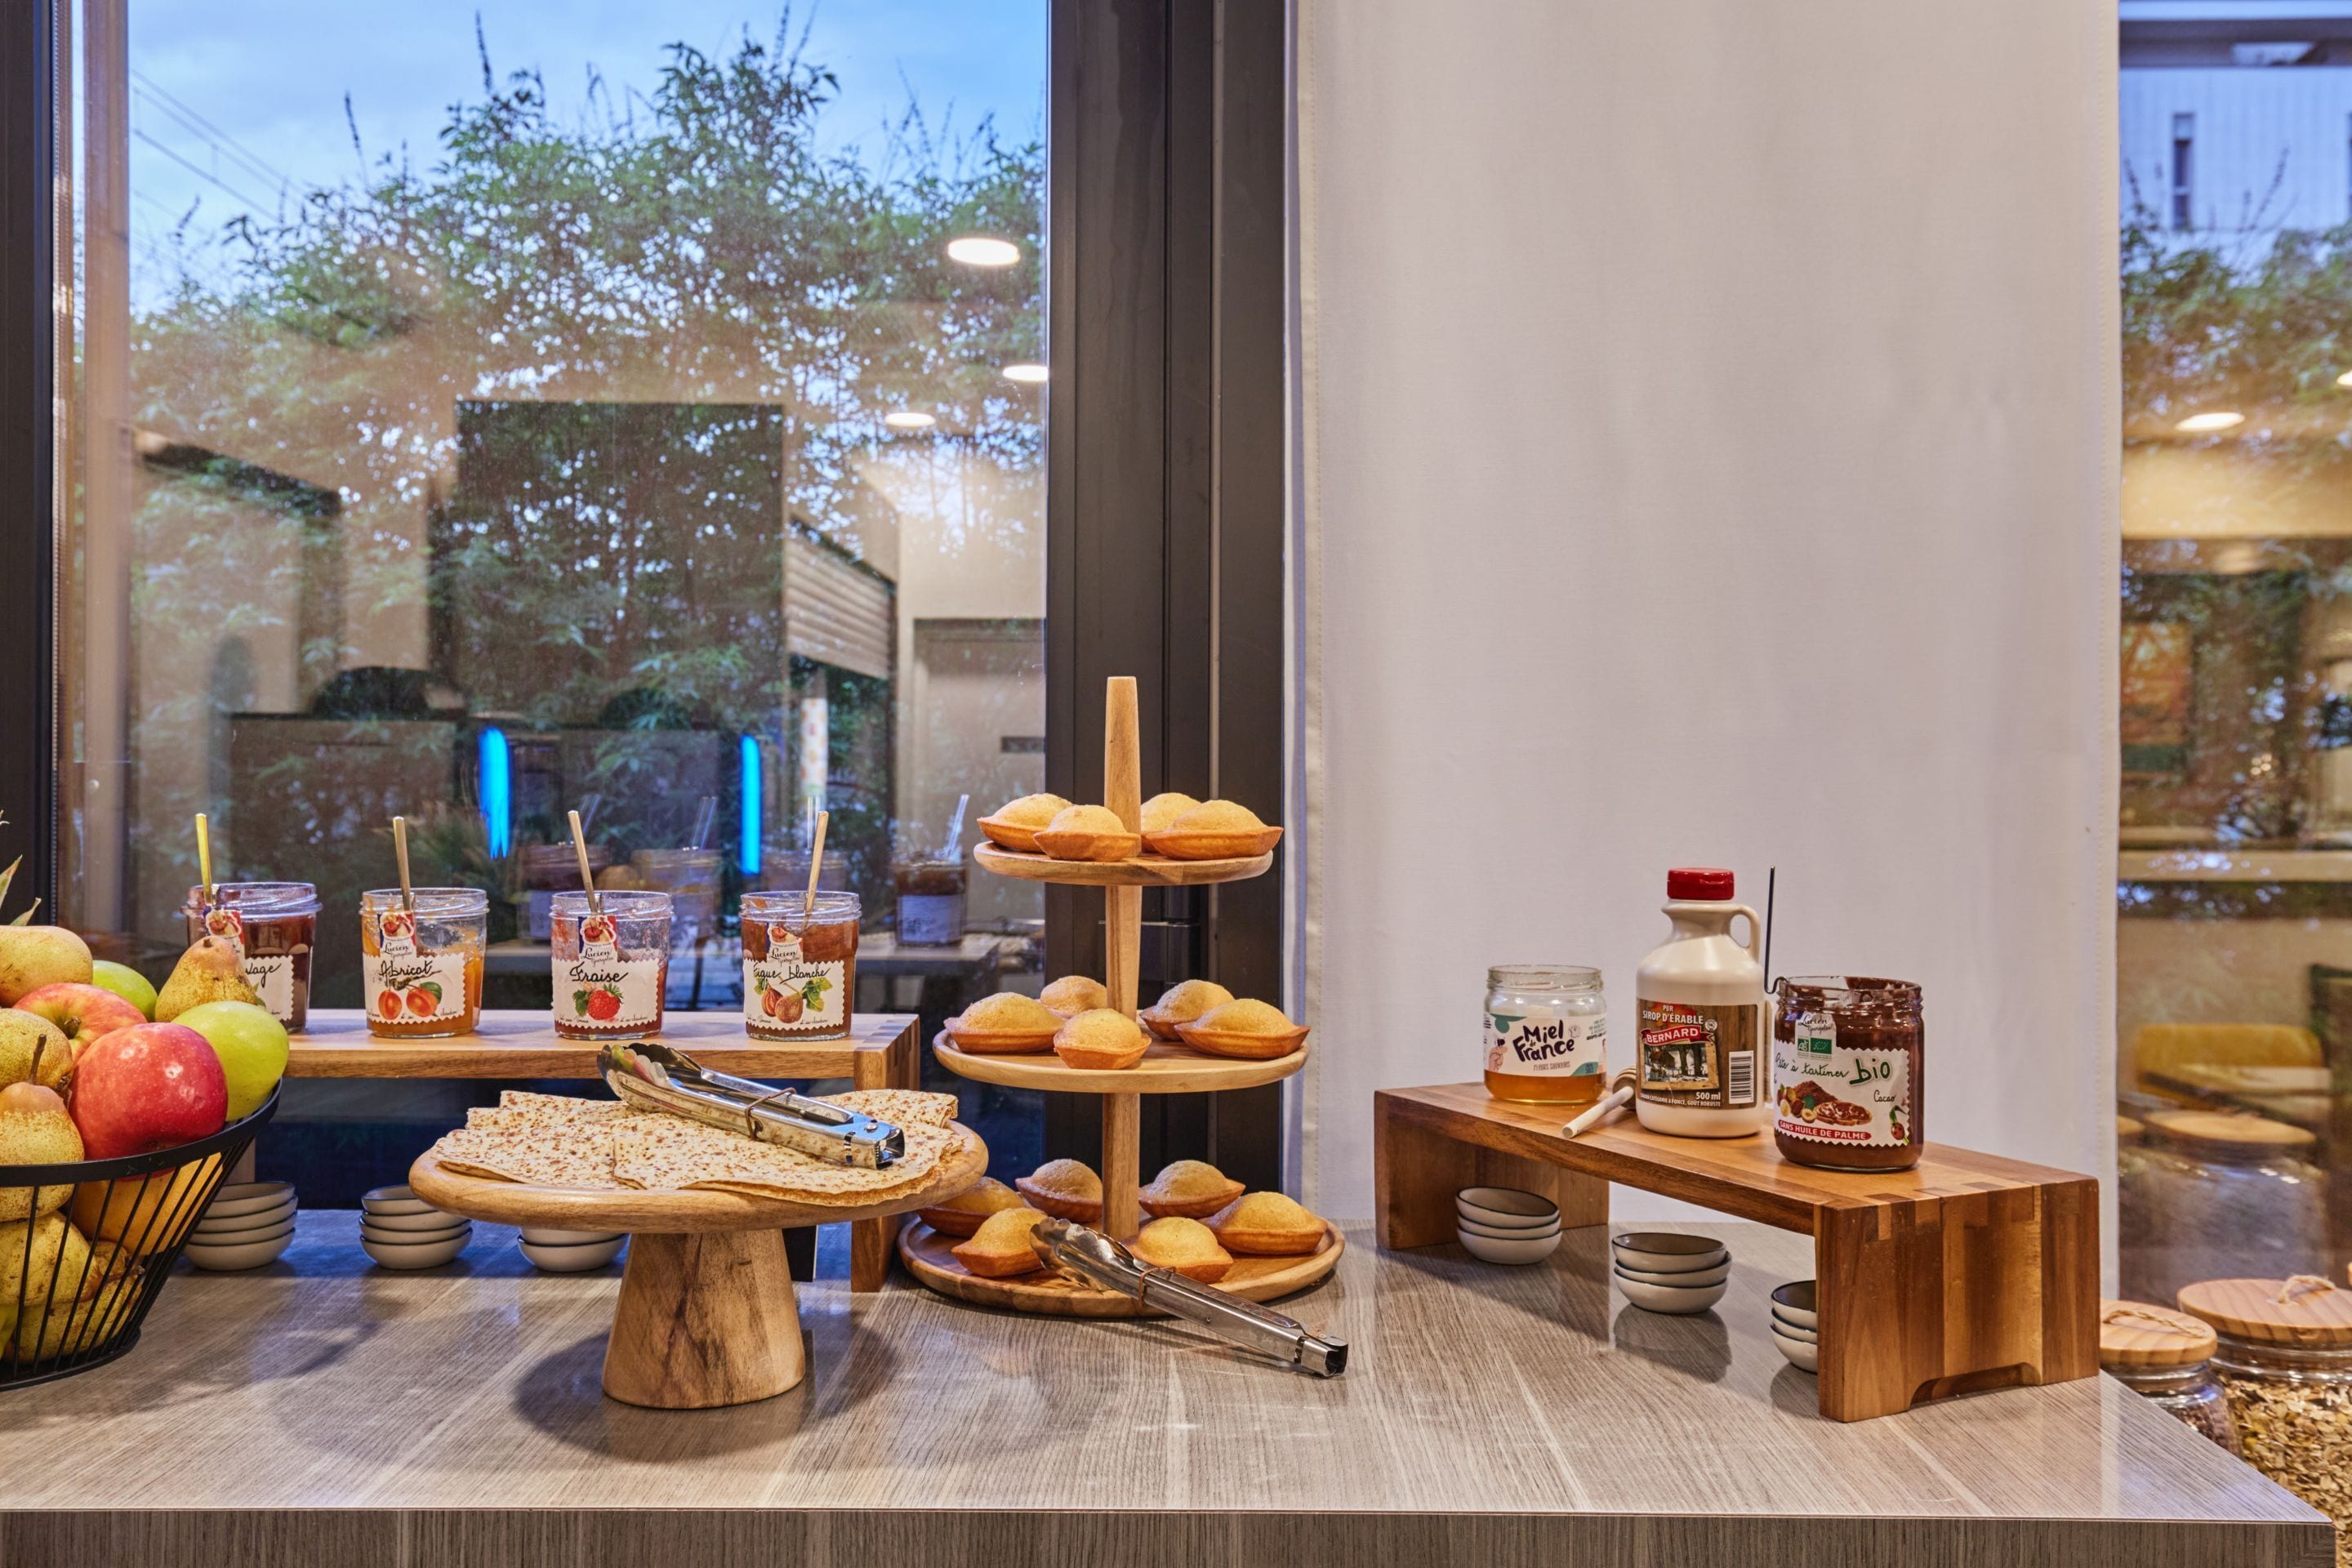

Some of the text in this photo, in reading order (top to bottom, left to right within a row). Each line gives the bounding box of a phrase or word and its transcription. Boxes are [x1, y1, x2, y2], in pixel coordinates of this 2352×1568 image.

[381, 942, 409, 954] Lucien
[581, 947, 611, 960] Lucien
[768, 947, 797, 960] Lucien
[246, 962, 282, 988] vage
[379, 960, 433, 987] Abricot
[569, 961, 629, 982] Fraise
[780, 964, 831, 984] blanche
[1642, 1010, 1704, 1025] SIROP D'ÉRABLE
[1798, 1014, 1828, 1027] Lucien
[1523, 1019, 1564, 1043] Miel
[1646, 1028, 1699, 1044] BERNARD
[1512, 1036, 1575, 1062] France
[1530, 1039, 1536, 1047] de
[1802, 1062, 1849, 1077] tartiner
[1849, 1058, 1891, 1085] bio
[1695, 1092, 1721, 1100] 500 ml
[1873, 1090, 1895, 1102] Cacao
[1780, 1120, 1866, 1141] SANS HUILE DE PALME
